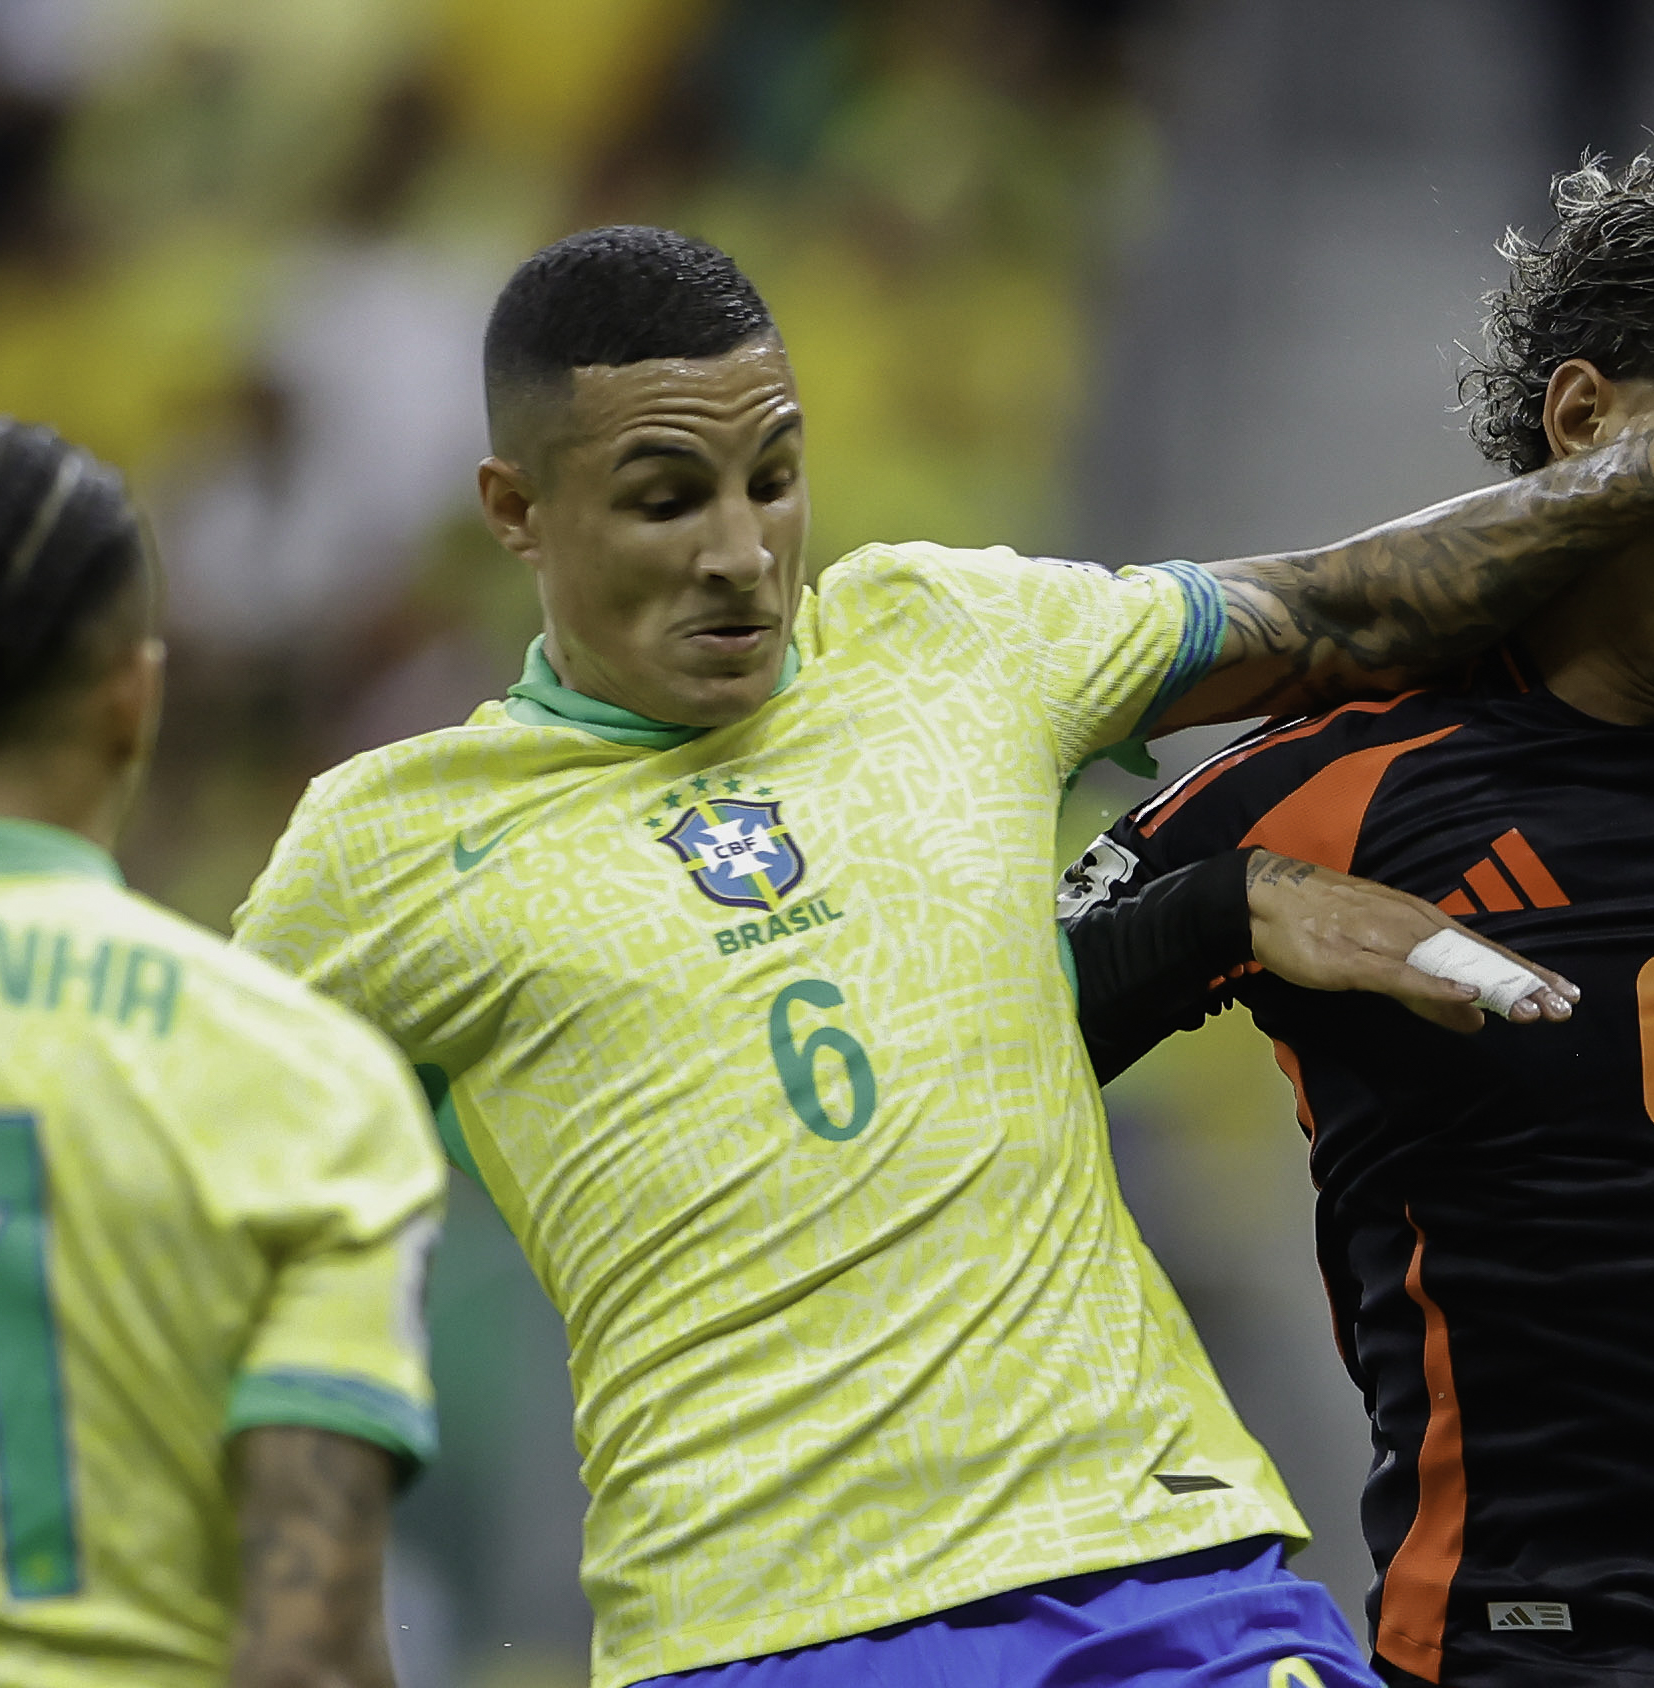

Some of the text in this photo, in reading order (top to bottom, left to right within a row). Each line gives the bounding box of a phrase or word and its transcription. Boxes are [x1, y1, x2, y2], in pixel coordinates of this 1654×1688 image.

[714, 836, 757, 858] CBF
[715, 900, 843, 955] BRASIL
[770, 979, 876, 1142] 6
